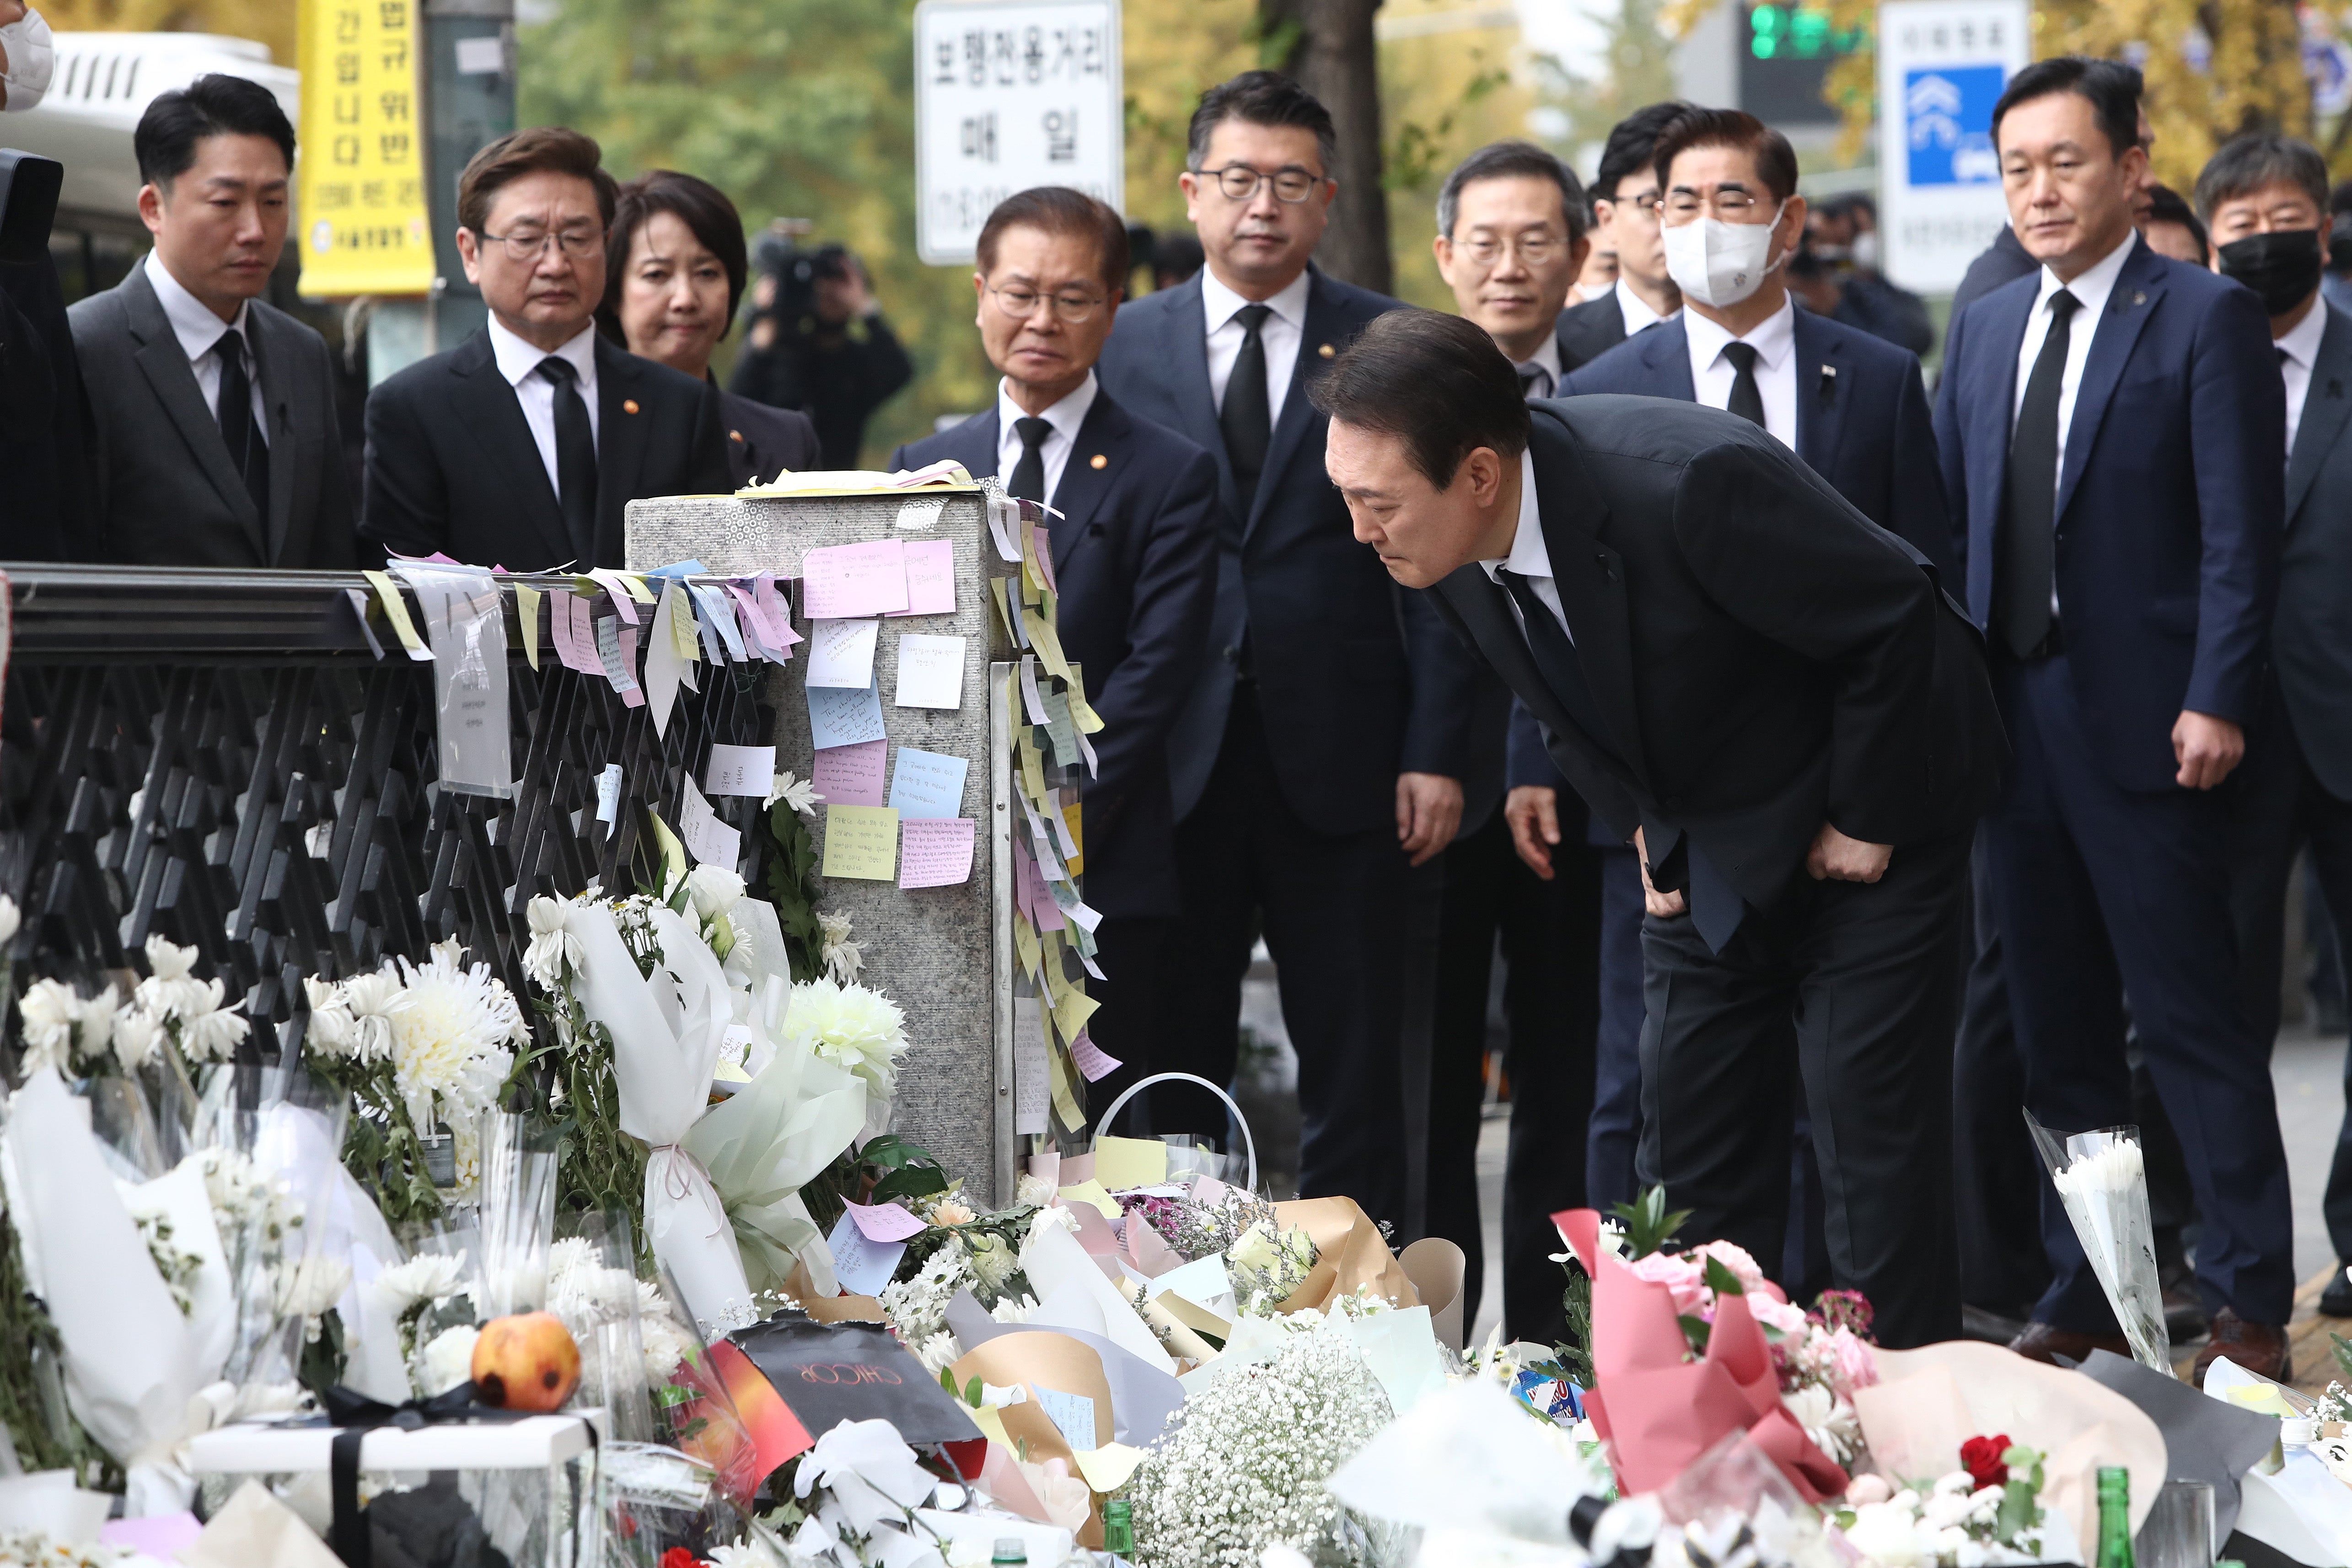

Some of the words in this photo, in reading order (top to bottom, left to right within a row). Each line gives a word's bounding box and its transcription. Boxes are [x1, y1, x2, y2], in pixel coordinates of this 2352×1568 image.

[935, 24, 1108, 87] 보행전용거리
[821, 708, 835, 717] This
[838, 696, 852, 709] should
[823, 720, 836, 730] have
[850, 696, 866, 712] allowed
[847, 714, 856, 722] I
[857, 708, 867, 718] feel
[793, 1363, 902, 1385] CHICOR
